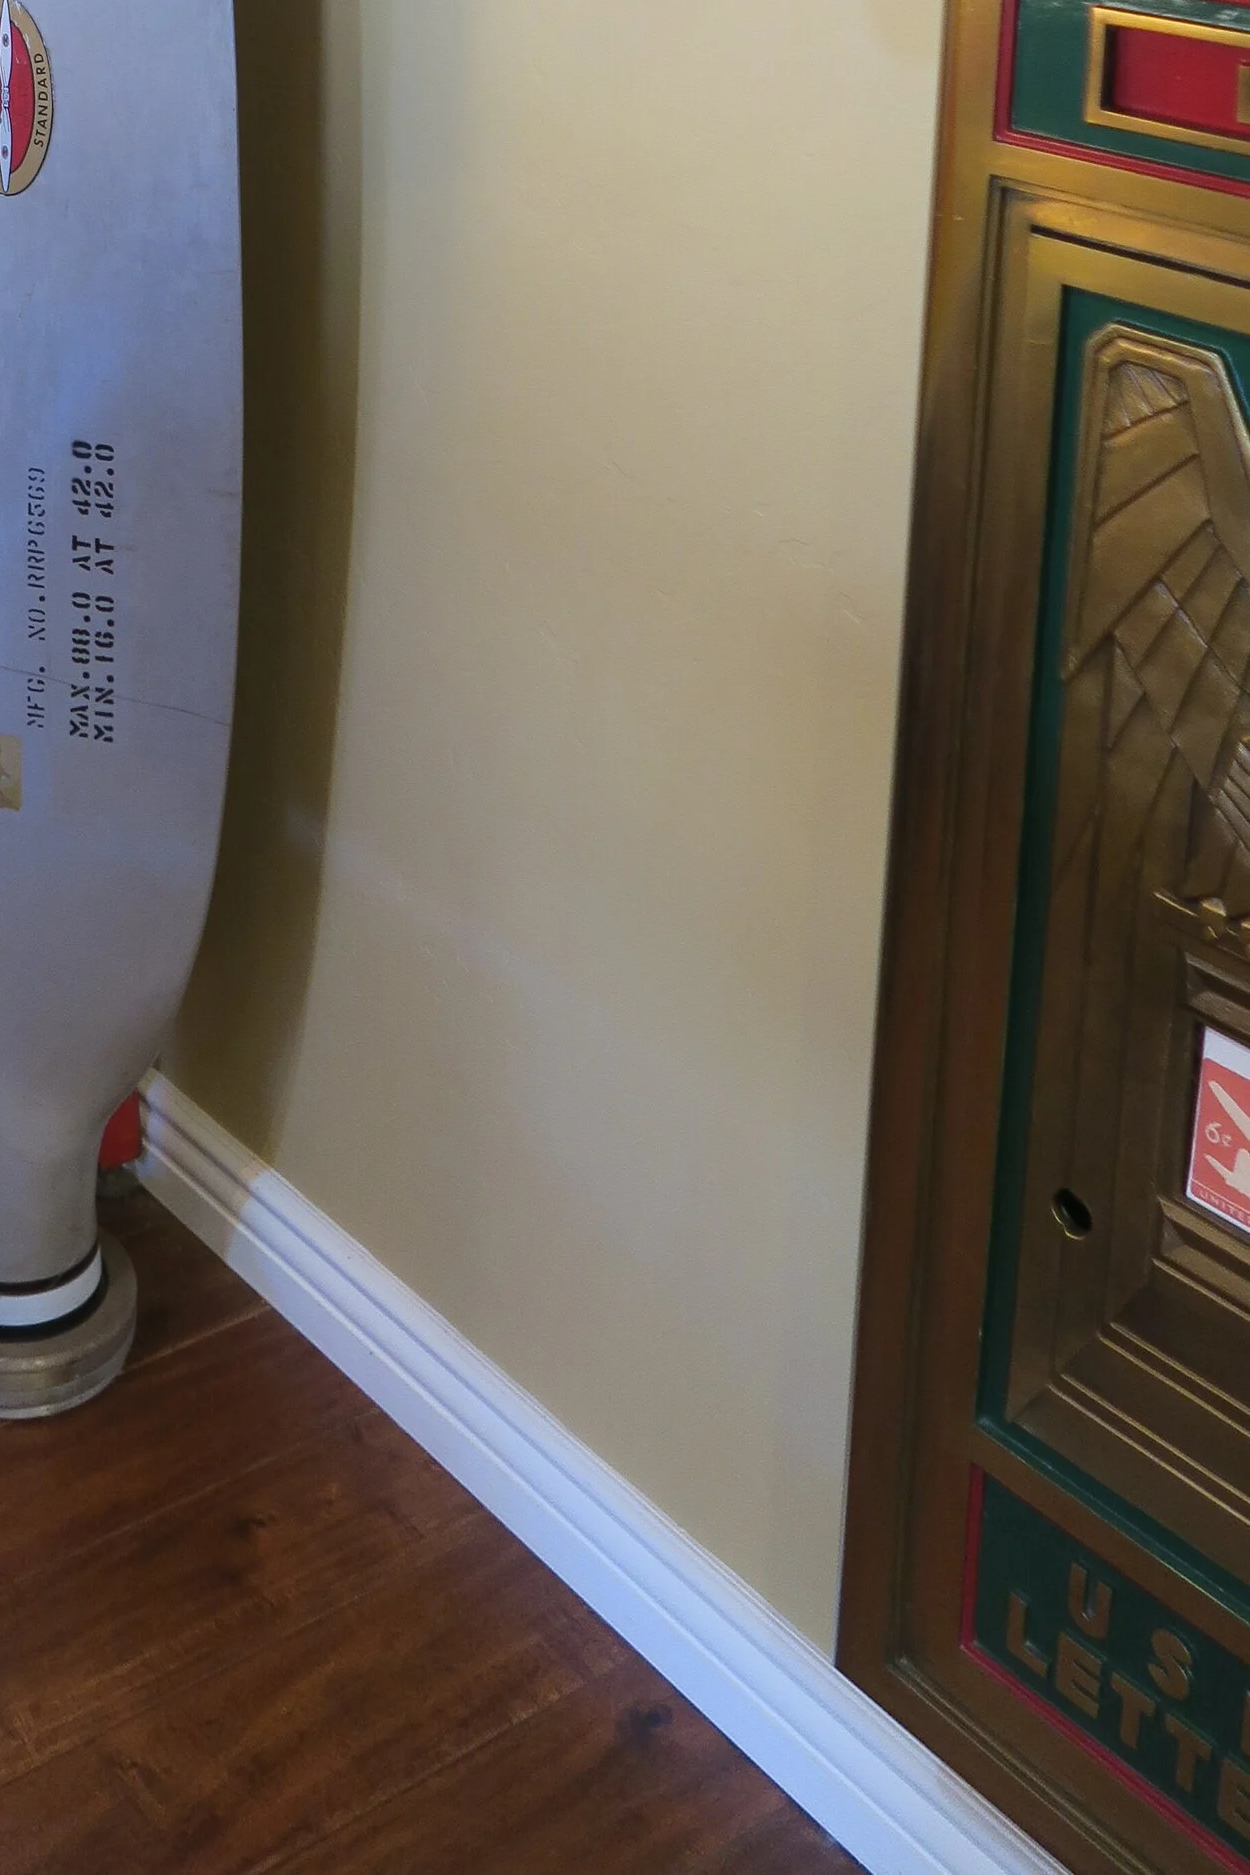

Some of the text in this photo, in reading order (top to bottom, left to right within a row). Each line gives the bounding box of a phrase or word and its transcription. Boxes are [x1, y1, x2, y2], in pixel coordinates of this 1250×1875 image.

[33, 53, 49, 147] STANDARD
[72, 440, 92, 516] 42.0
[95, 444, 114, 518] 42.0
[72, 535, 91, 571] AT
[95, 538, 114, 575] AT
[1067, 1561, 1193, 1701] U S
